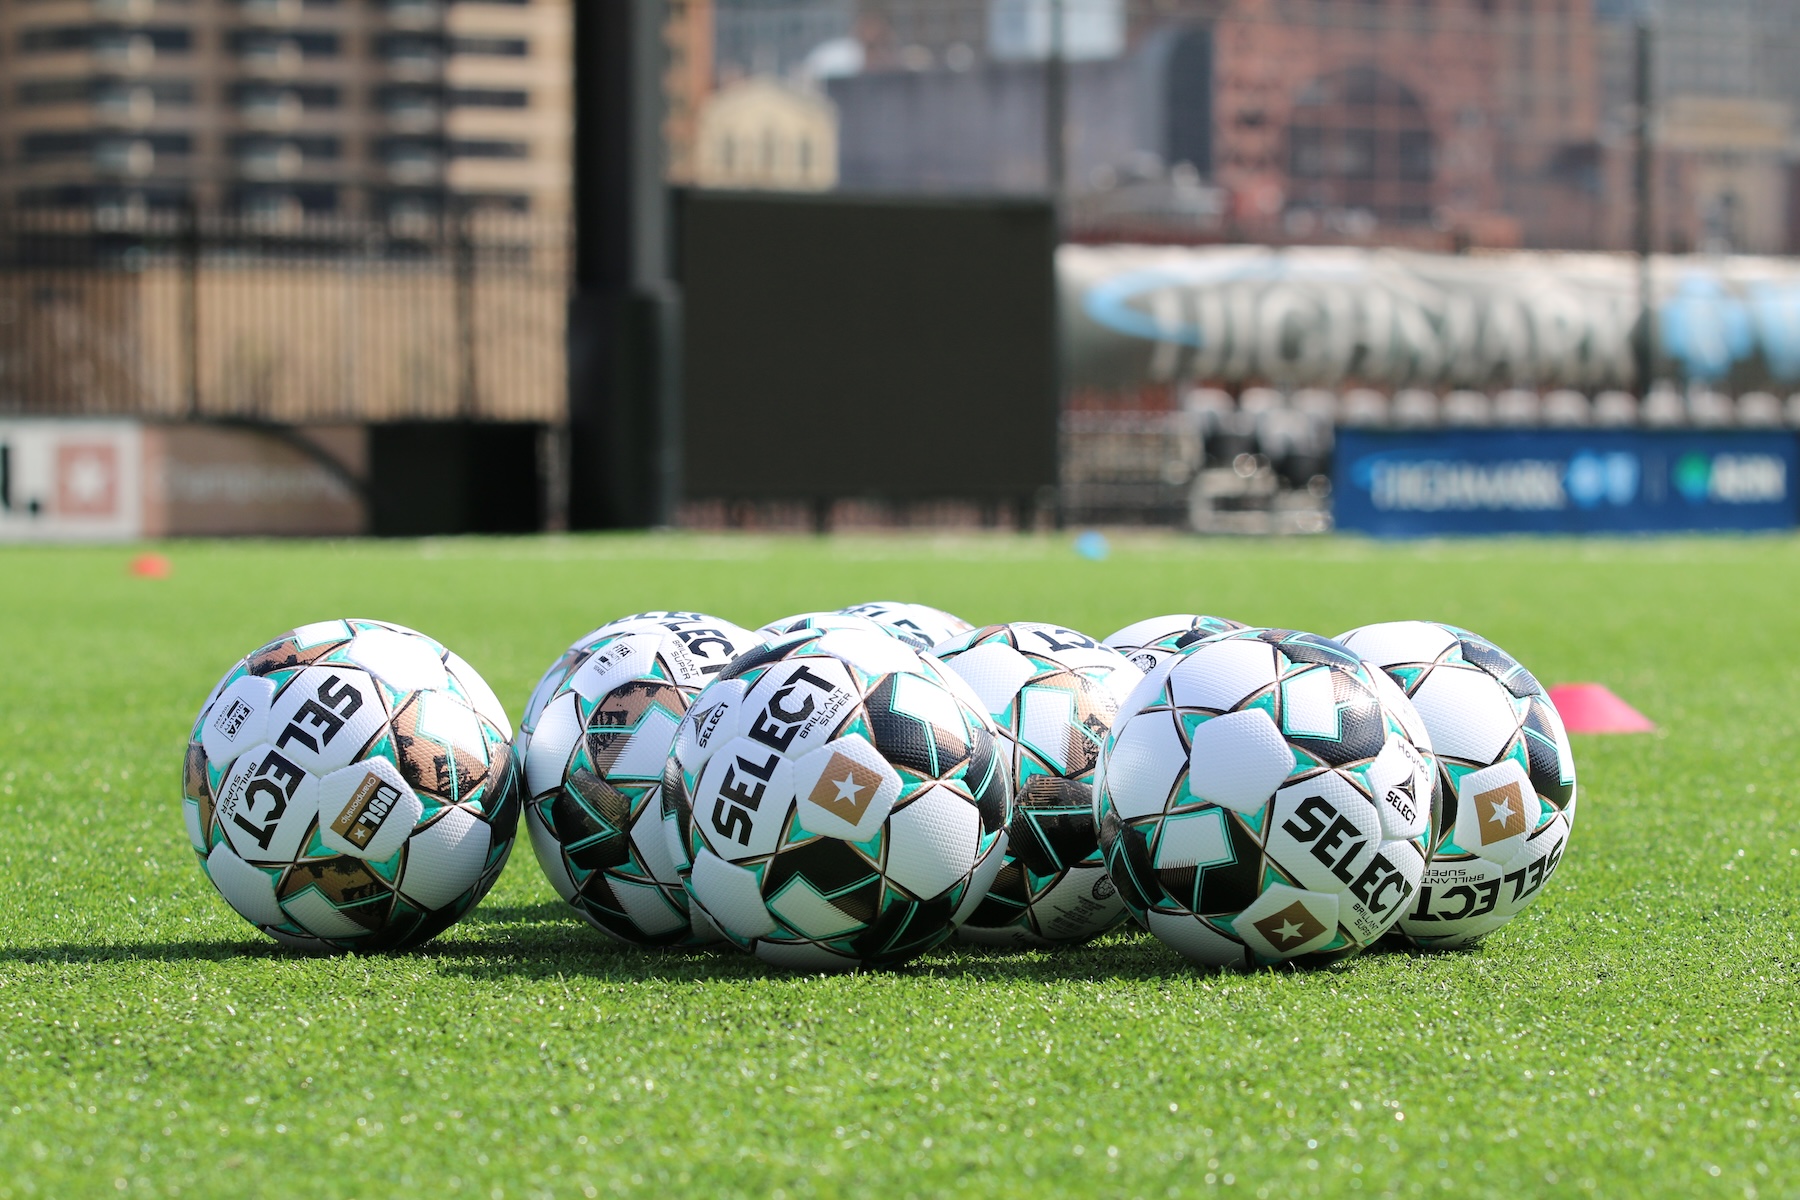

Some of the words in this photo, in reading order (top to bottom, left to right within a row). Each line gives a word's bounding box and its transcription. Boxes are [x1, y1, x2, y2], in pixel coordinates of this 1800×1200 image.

[670, 651, 691, 680] SUPER
[227, 706, 251, 735] FIFA
[698, 702, 729, 748] SELECT
[799, 687, 843, 739] BRILLANT
[819, 692, 853, 727] SUPER
[233, 674, 364, 851] SELECT
[711, 665, 836, 847] SELECT
[220, 774, 241, 814] SUPER
[227, 762, 257, 820] BRILLANT
[340, 777, 377, 825] Championship
[357, 785, 399, 826] USL
[1385, 790, 1417, 826] SELECT
[1281, 796, 1414, 925] SELECT
[1408, 835, 1564, 922] SELECT
[1421, 873, 1485, 885] BRILLANT
